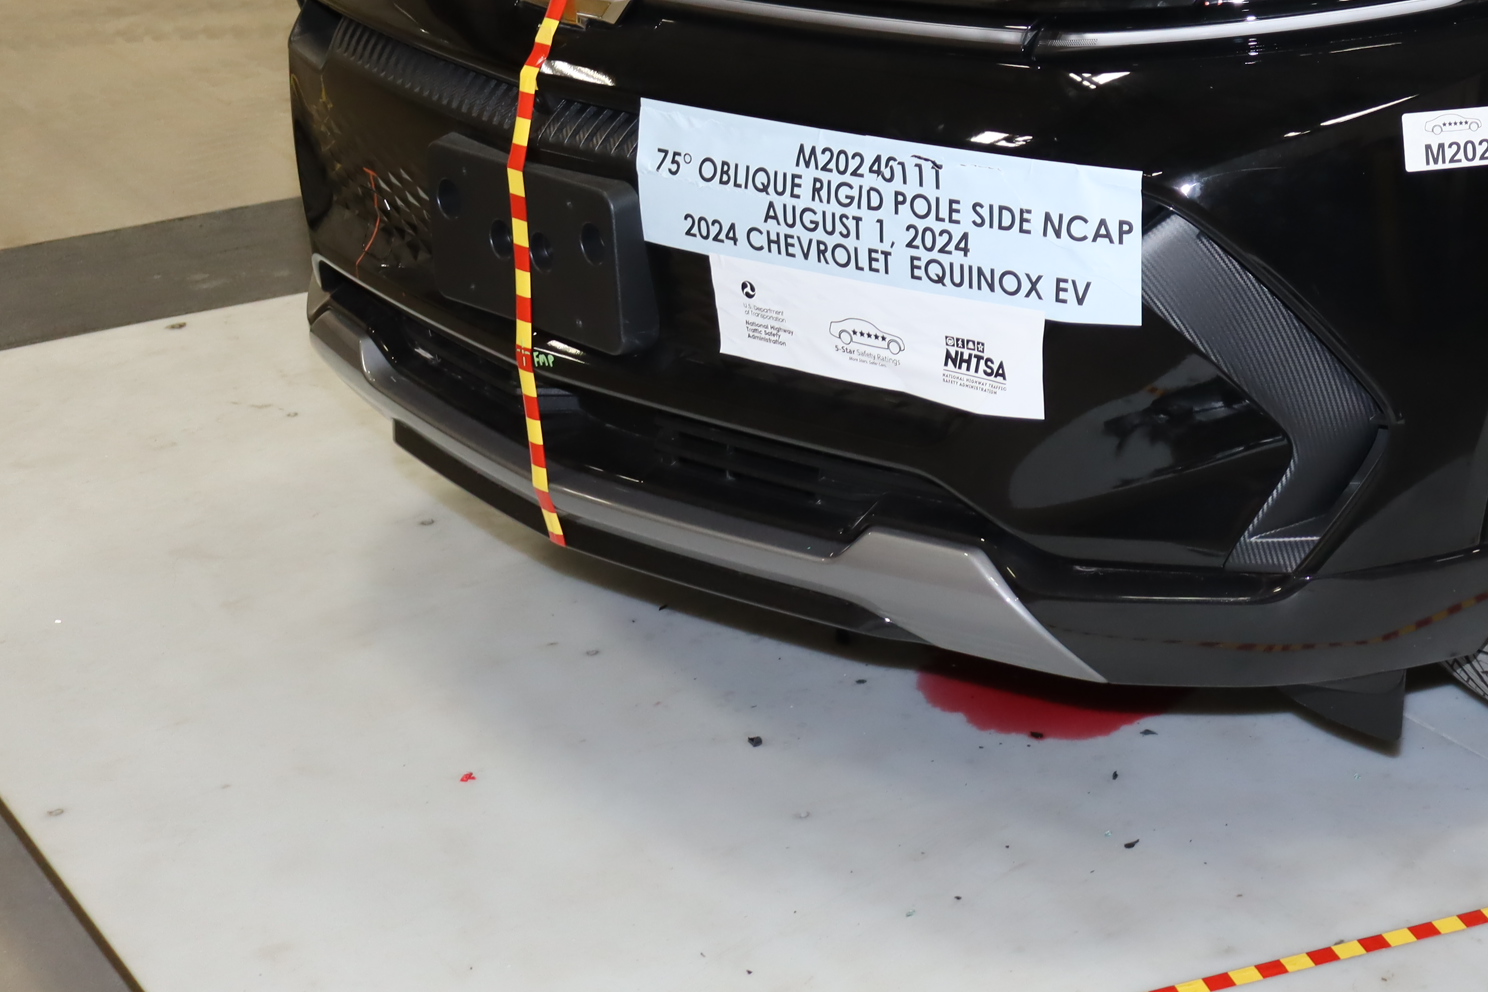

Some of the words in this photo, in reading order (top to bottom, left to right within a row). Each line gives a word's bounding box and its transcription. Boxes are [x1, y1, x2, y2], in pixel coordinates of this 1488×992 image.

[699, 157, 803, 199] OBLIQUE
[811, 176, 884, 211] RIGID
[894, 190, 961, 225] POLE
[971, 202, 1032, 235] SIDE
[1042, 211, 1134, 245] NCAP
[763, 200, 863, 240] AUGUST
[905, 223, 971, 257] 2024
[683, 213, 738, 246] 2024
[746, 226, 892, 275] CHEVROLET
[910, 255, 1044, 301] EQUINOX
[1055, 277, 1092, 306] EV
[745, 320, 769, 330] National
[746, 326, 763, 335] Traffic
[764, 329, 781, 339] Safety
[747, 333, 787, 346] Administration
[533, 351, 555, 368] FMP
[834, 344, 855, 355] 5-Star
[856, 349, 876, 360] Safety
[877, 353, 901, 366] Ratings
[943, 347, 1007, 381] NHTSA
[942, 373, 965, 381] NATIONAL
[966, 378, 987, 387] HIGHWAY
[959, 382, 998, 395] ADMINISTRATION
